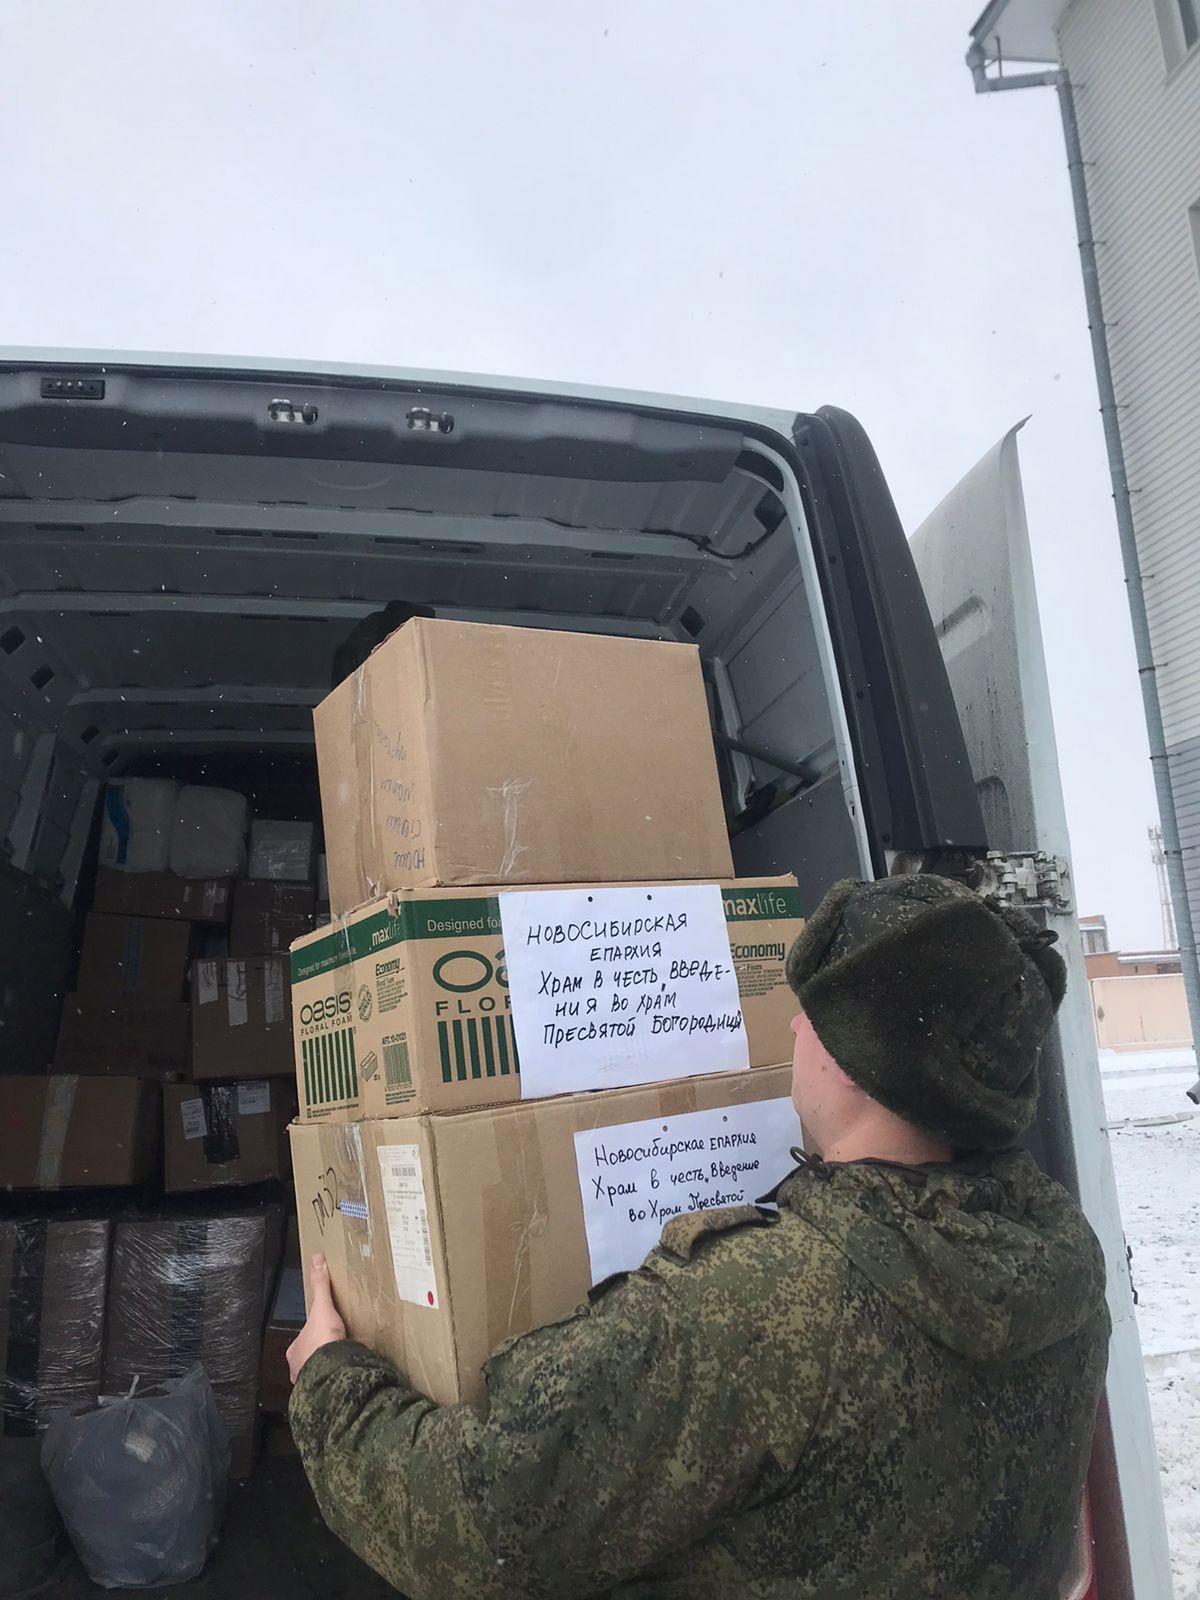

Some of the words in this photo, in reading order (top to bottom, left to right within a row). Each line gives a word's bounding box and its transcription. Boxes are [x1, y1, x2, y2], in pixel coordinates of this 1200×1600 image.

[427, 917, 483, 933] Designed
[526, 912, 688, 946] НОВОСИБИРСКАЯ
[590, 941, 663, 962] ЕПАРХИЯ
[300, 1021, 330, 1037] FLORAL
[331, 1014, 353, 1029] FOAM
